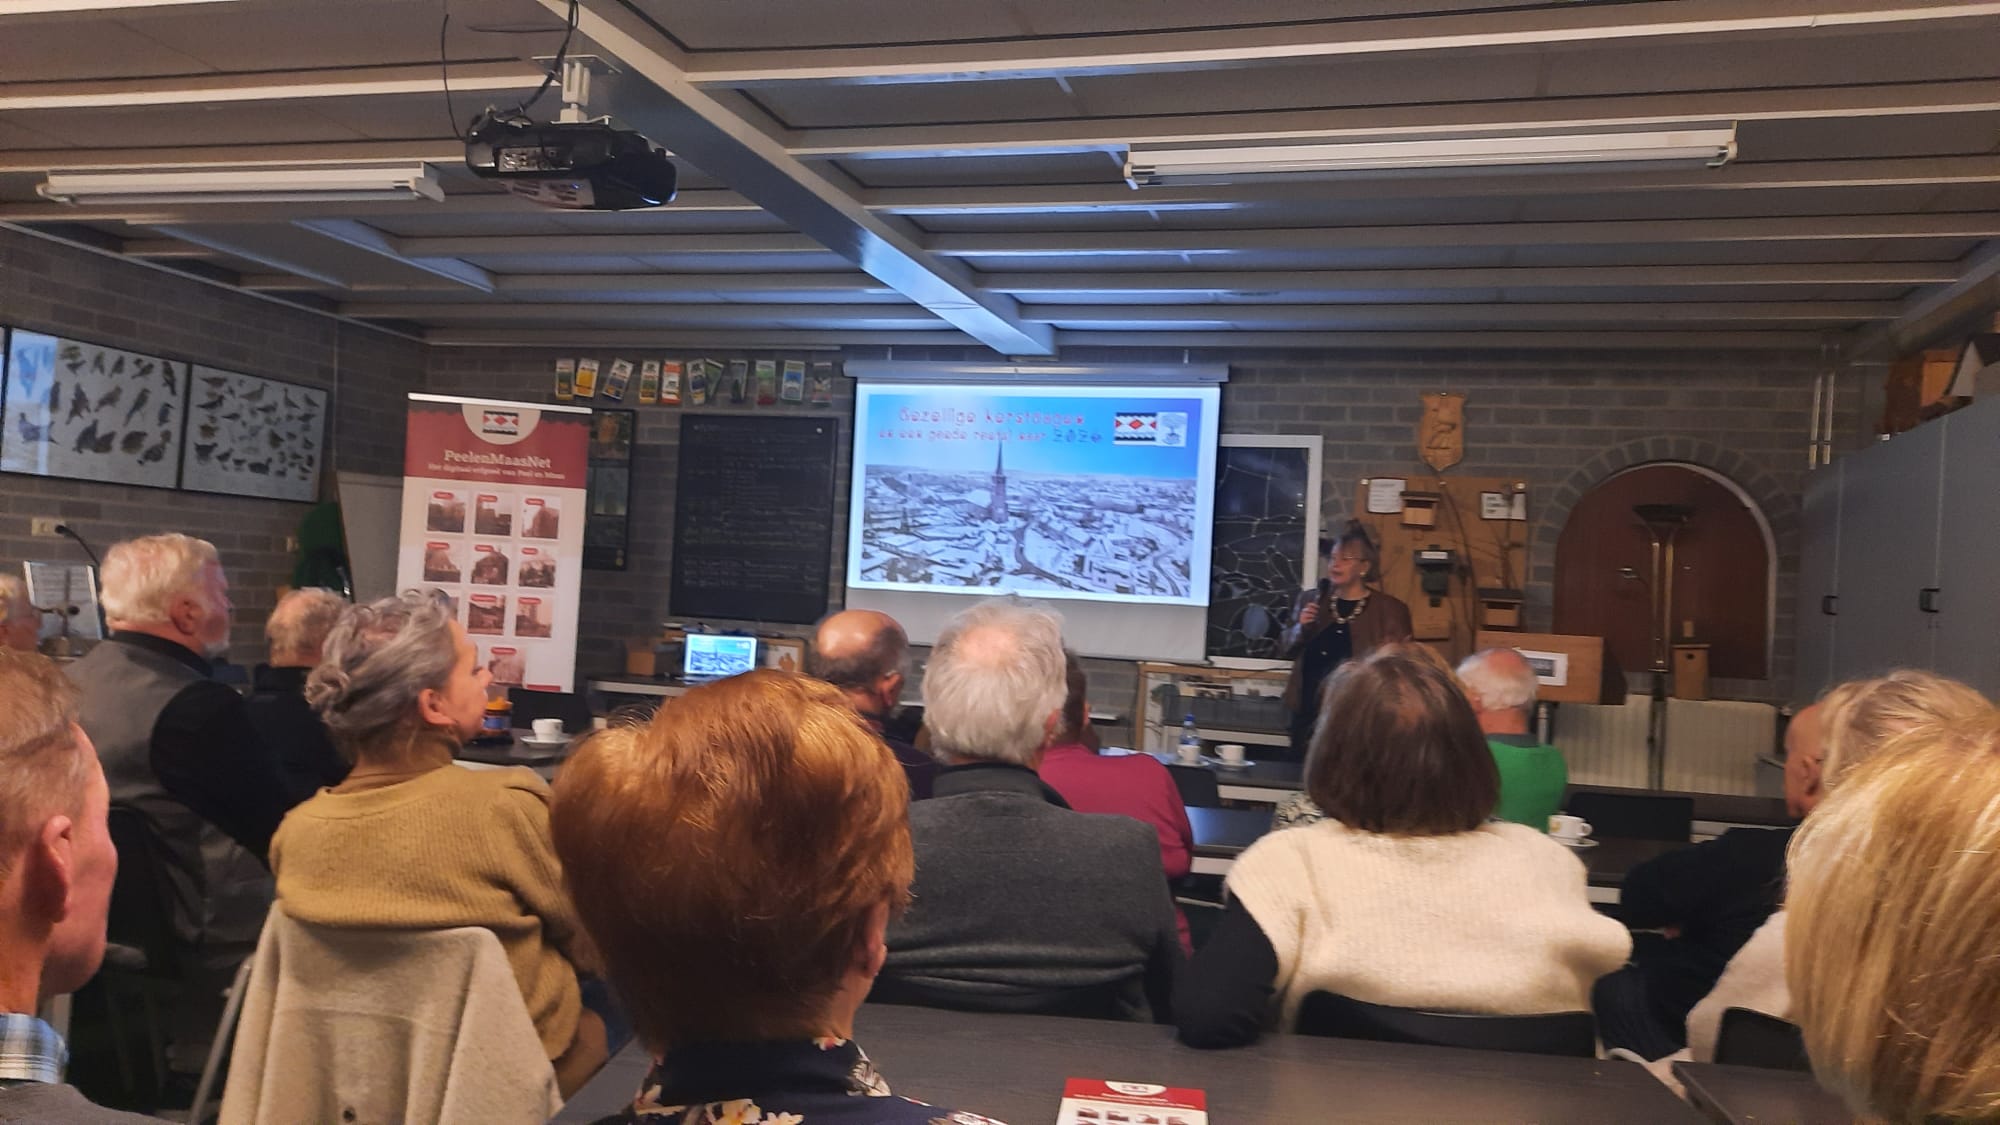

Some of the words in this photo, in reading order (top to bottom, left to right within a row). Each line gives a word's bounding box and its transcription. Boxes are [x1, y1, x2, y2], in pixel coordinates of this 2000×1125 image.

[899, 406, 976, 426] Gezellige
[985, 409, 1085, 428] kerstdagen
[444, 449, 551, 469] PeelenMaasNet
